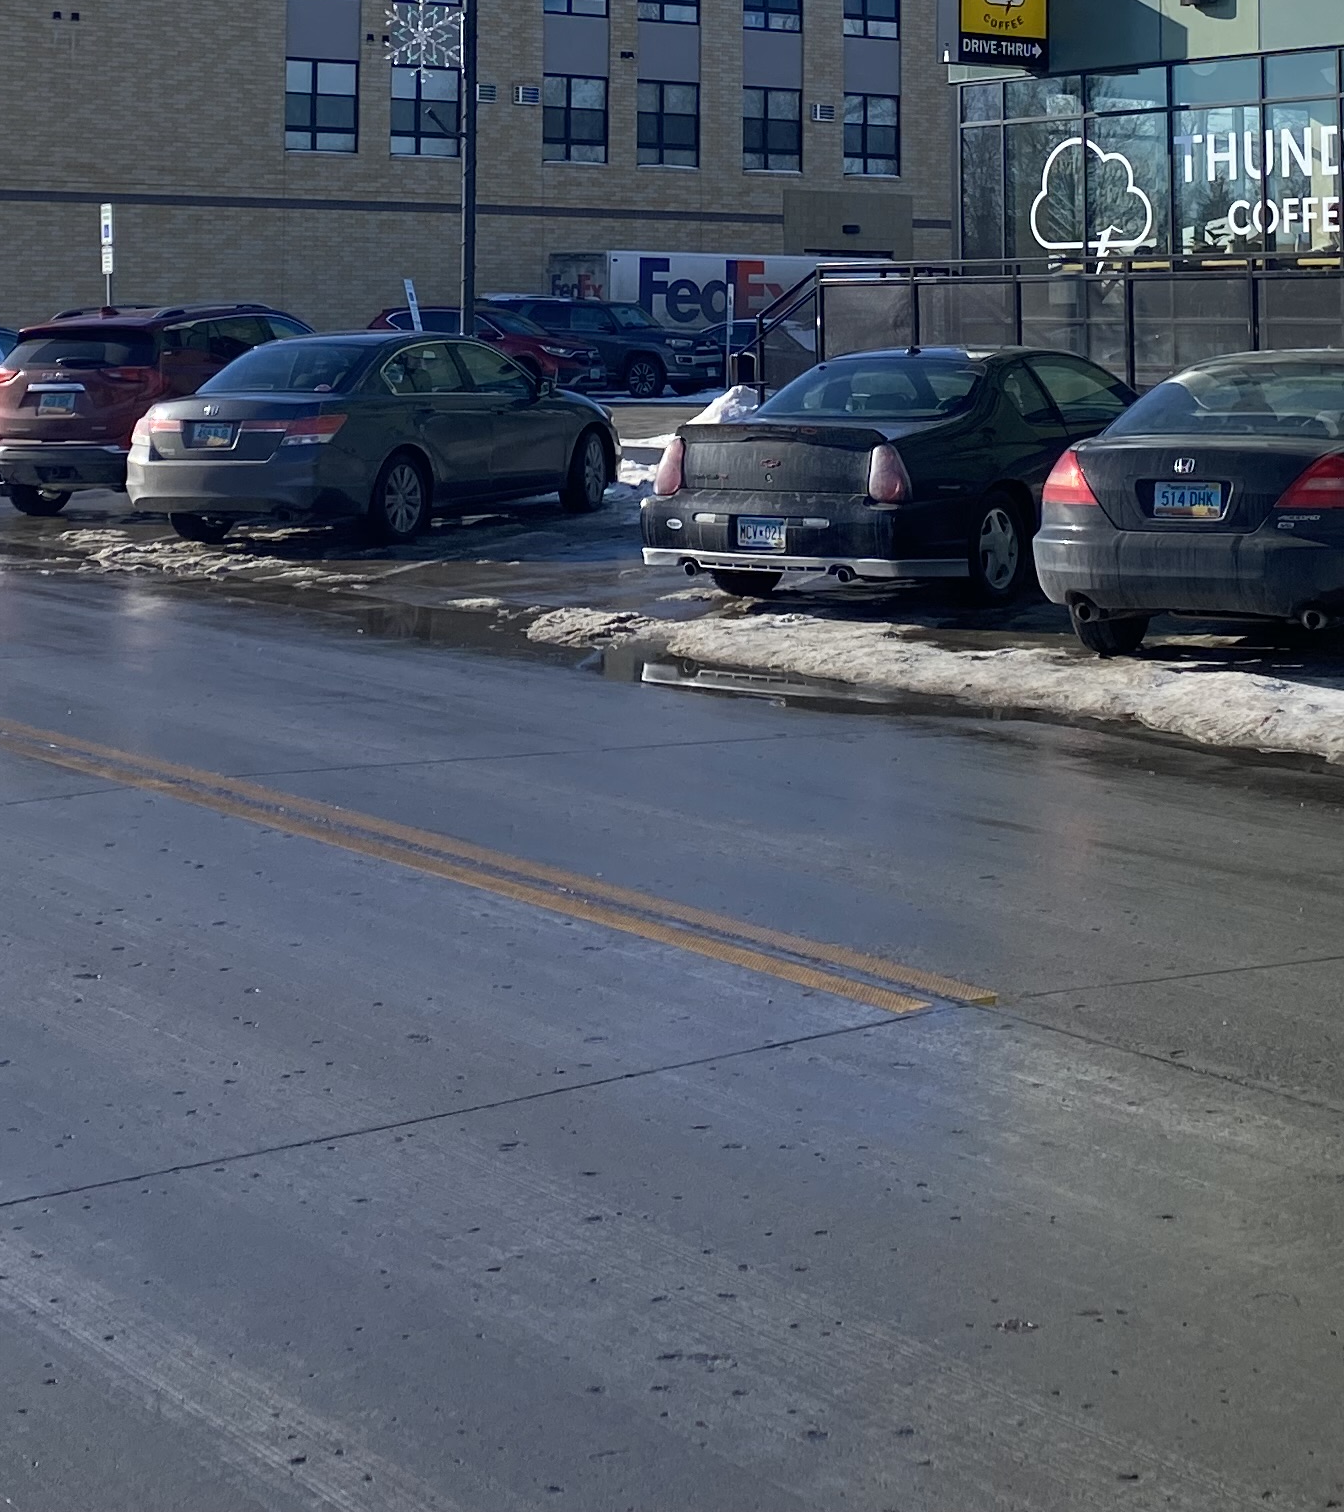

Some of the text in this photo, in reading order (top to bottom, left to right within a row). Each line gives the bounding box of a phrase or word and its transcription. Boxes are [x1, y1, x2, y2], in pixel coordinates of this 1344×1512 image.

[983, 13, 1024, 30] COFFEE
[962, 38, 1032, 57] DRIVE-THRU
[1161, 490, 1214, 507] 514 DHK
